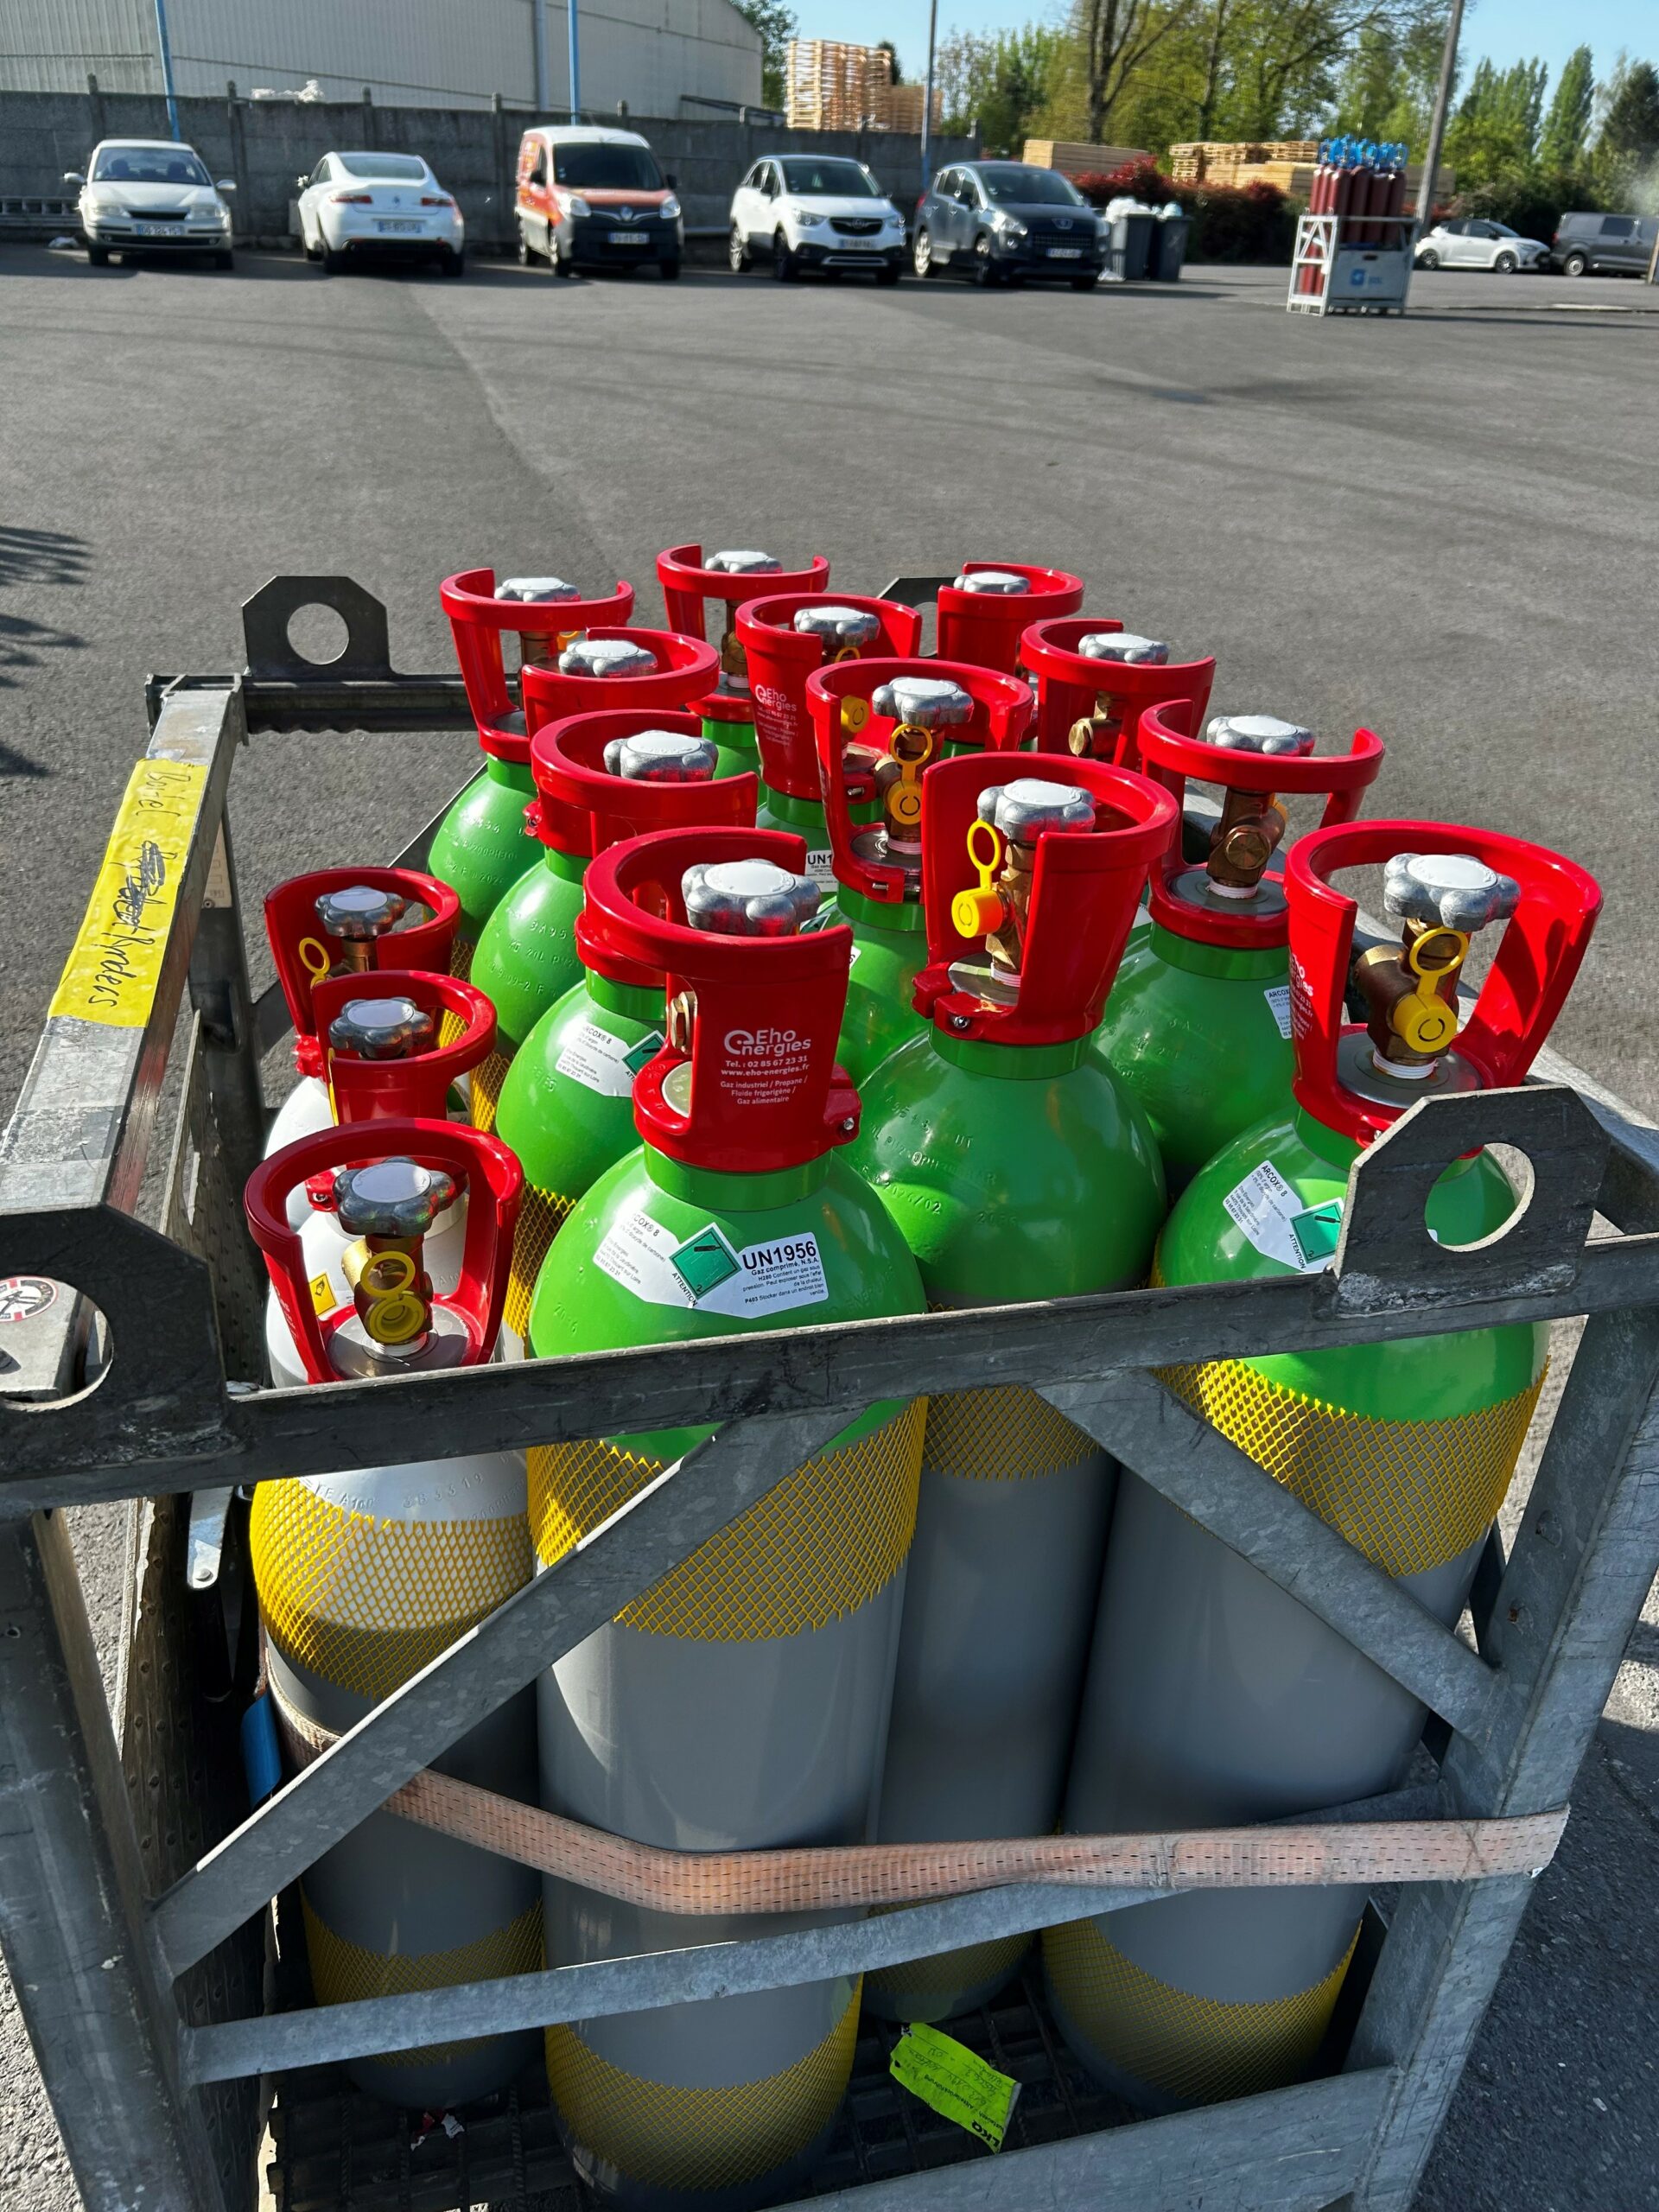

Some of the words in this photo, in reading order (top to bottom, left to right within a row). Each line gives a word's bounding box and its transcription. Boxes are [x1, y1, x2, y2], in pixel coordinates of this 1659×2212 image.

[766, 687, 787, 702] Eho
[756, 1027, 797, 1045] Eho
[798, 1055, 808, 1064] 31
[721, 1064, 810, 1077] www.eho-energies.fr
[735, 1080, 768, 1089] industriel
[775, 1077, 803, 1087] Propane
[742, 1241, 817, 1270] UN1956
[1289, 1234, 1306, 1269] ATTENTION
[672, 1272, 698, 1306] ATTENTION
[971, 2120, 1001, 2147] LKQ
